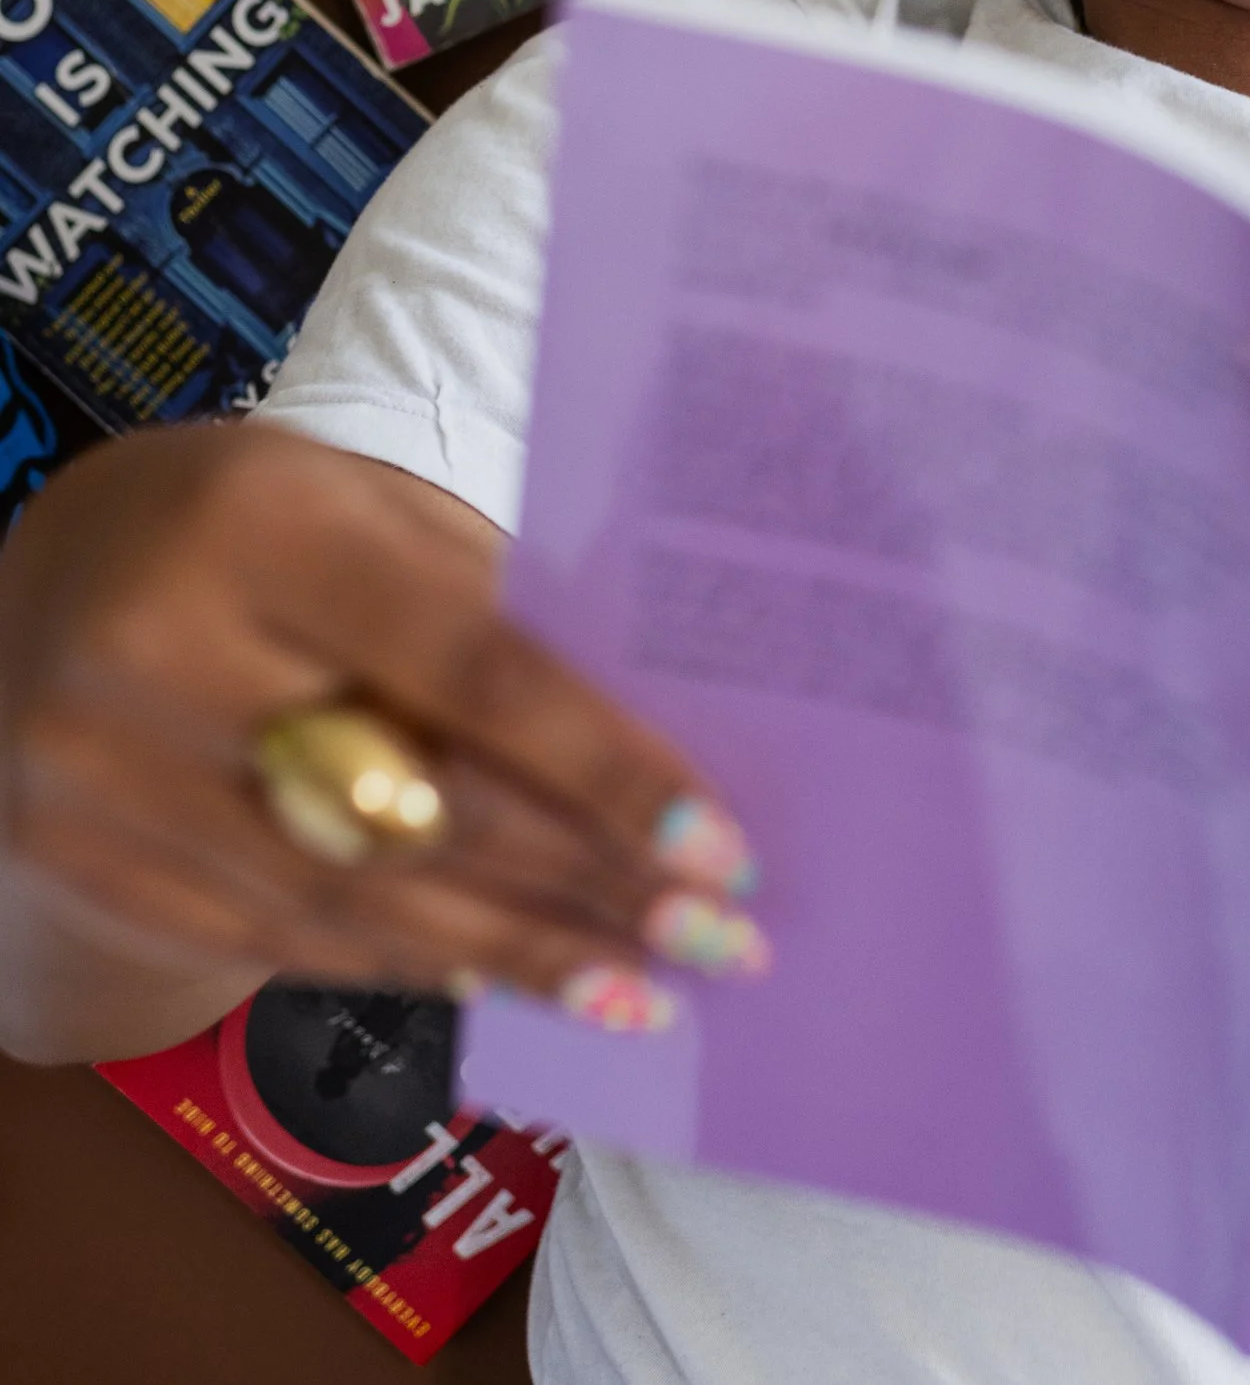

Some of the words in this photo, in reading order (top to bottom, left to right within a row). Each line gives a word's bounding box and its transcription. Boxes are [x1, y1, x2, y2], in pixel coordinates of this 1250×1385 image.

[34, 48, 111, 127] IS
[174, 1098, 214, 1135] HIDE
[212, 1130, 239, 1156] TO
[233, 1150, 319, 1233] SOMETHING
[388, 1122, 535, 1260] ALL
[316, 1228, 351, 1264] HAS
[348, 1260, 431, 1338] EVERYBODY
